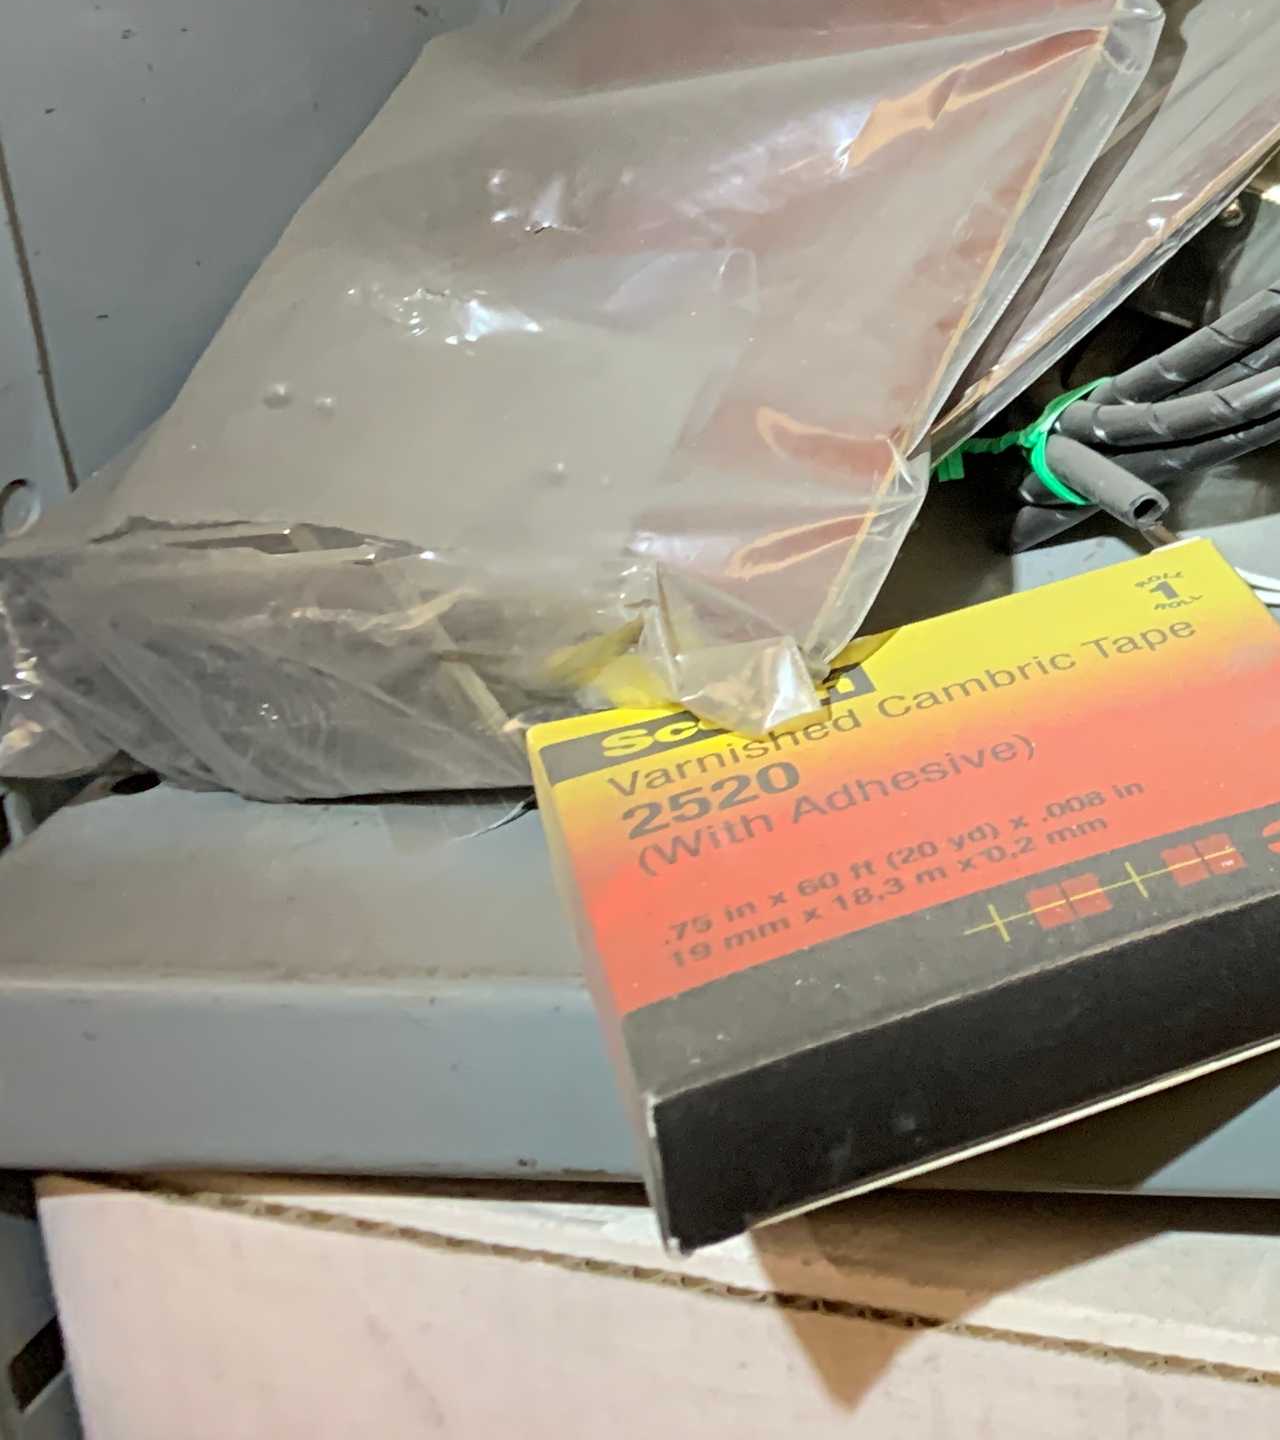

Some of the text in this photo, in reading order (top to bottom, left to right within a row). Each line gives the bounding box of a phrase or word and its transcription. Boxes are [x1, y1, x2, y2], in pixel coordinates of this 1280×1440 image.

[1148, 580, 1180, 602] 1
[607, 618, 1197, 798] Varnished Cambric Tape
[622, 761, 801, 841] 2520
[639, 733, 1036, 878] (With Adhesive)
[664, 779, 1145, 946] .75 in x 60 ft (20 yd) x .008 in
[671, 944, 713, 968] 19
[722, 916, 792, 951] mm
[802, 907, 824, 925] x
[915, 861, 948, 885] m
[960, 856, 981, 875] x
[1045, 817, 1109, 845] mm
